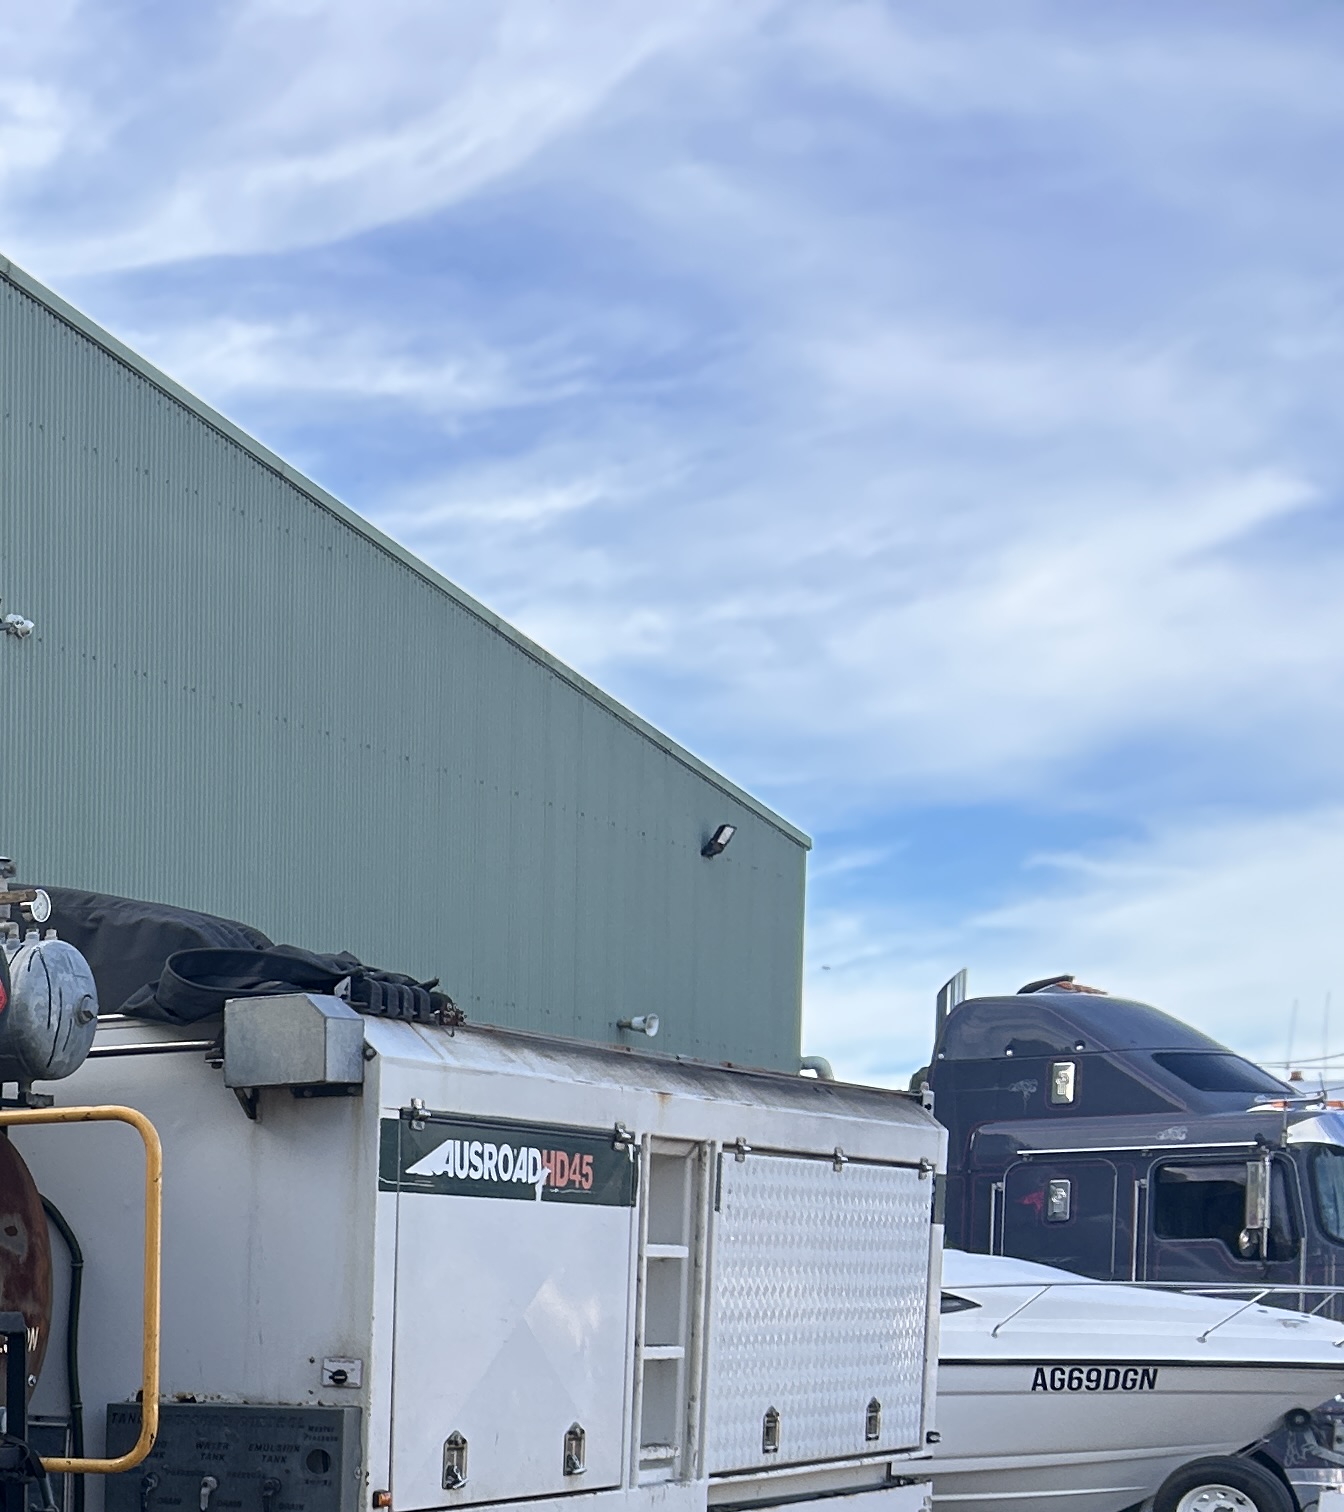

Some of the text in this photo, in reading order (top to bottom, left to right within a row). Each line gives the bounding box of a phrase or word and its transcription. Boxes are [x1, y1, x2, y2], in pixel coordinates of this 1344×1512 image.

[405, 1138, 594, 1190] AUSROAD HD45
[1031, 1366, 1159, 1392] AG69DGN
[248, 1443, 300, 1453] EMULSION
[261, 1454, 288, 1464] TANK
